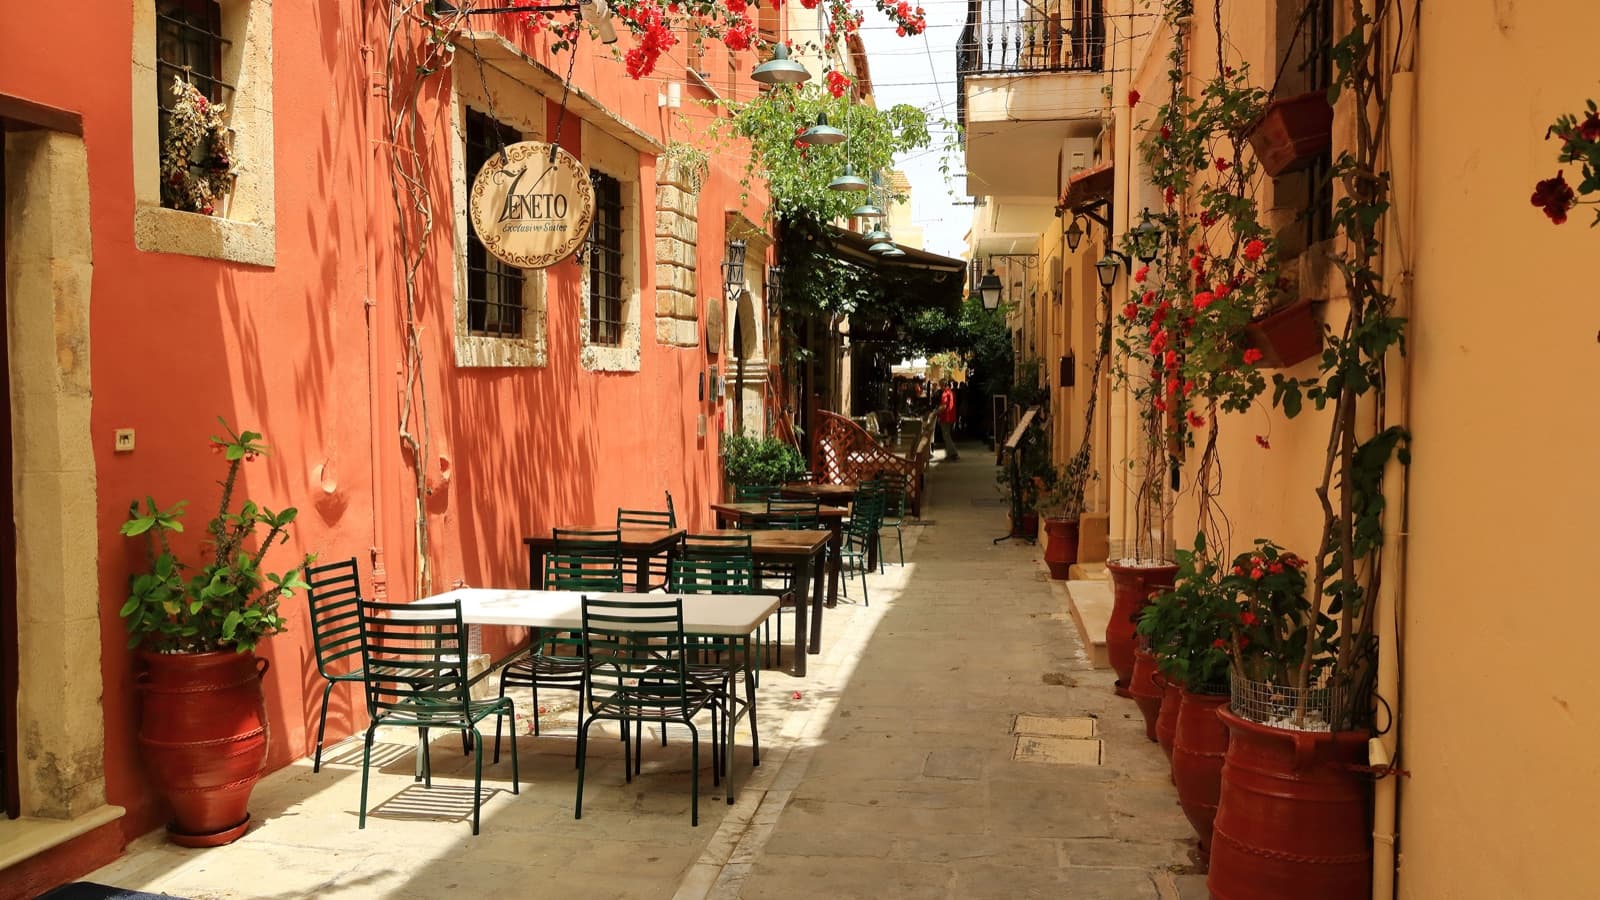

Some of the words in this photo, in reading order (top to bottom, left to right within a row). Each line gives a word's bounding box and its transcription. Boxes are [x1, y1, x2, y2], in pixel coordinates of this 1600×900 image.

[493, 165, 568, 223] VENETO
[502, 222, 542, 233] Exclusive
[543, 221, 568, 233] Suites
